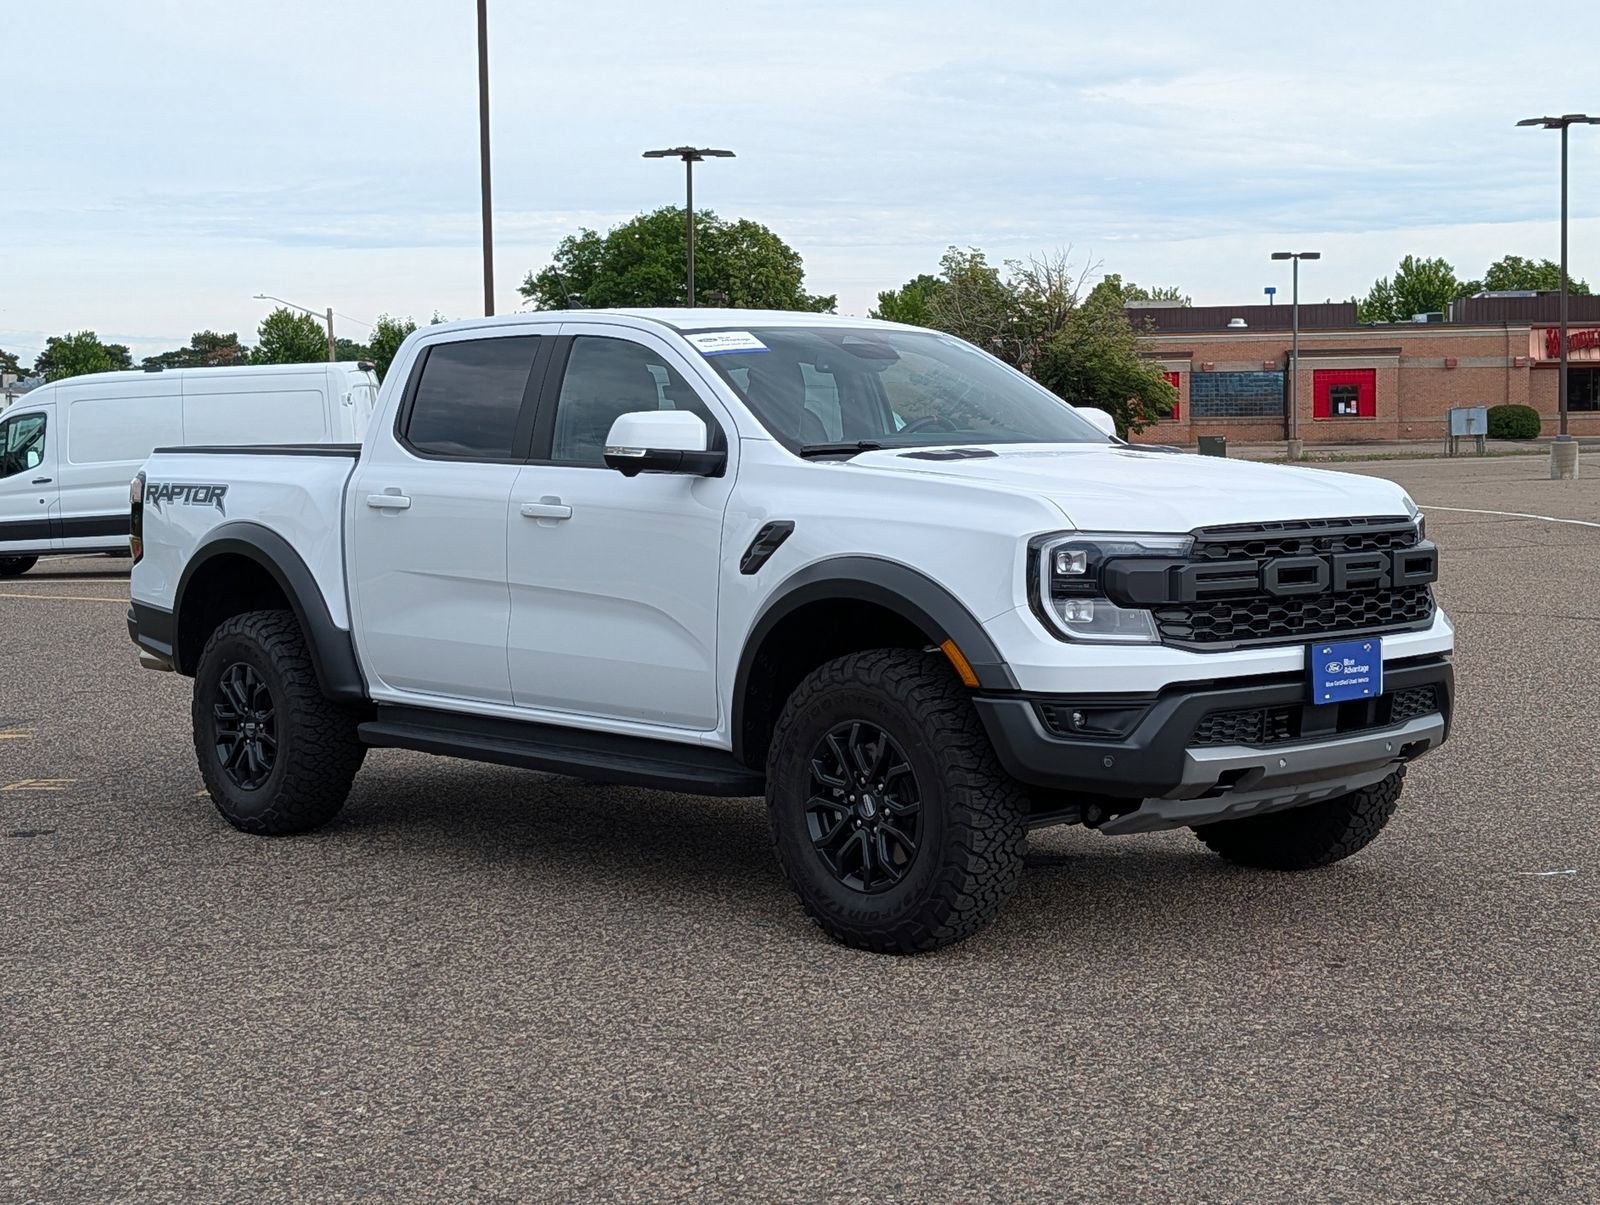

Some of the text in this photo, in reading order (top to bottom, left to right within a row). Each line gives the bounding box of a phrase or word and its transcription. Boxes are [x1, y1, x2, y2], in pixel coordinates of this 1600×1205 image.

[145, 483, 229, 518] RAPTOR
[1178, 542, 1438, 604] FORD
[1343, 658, 1355, 667] Blue
[1343, 665, 1369, 674] Advantage
